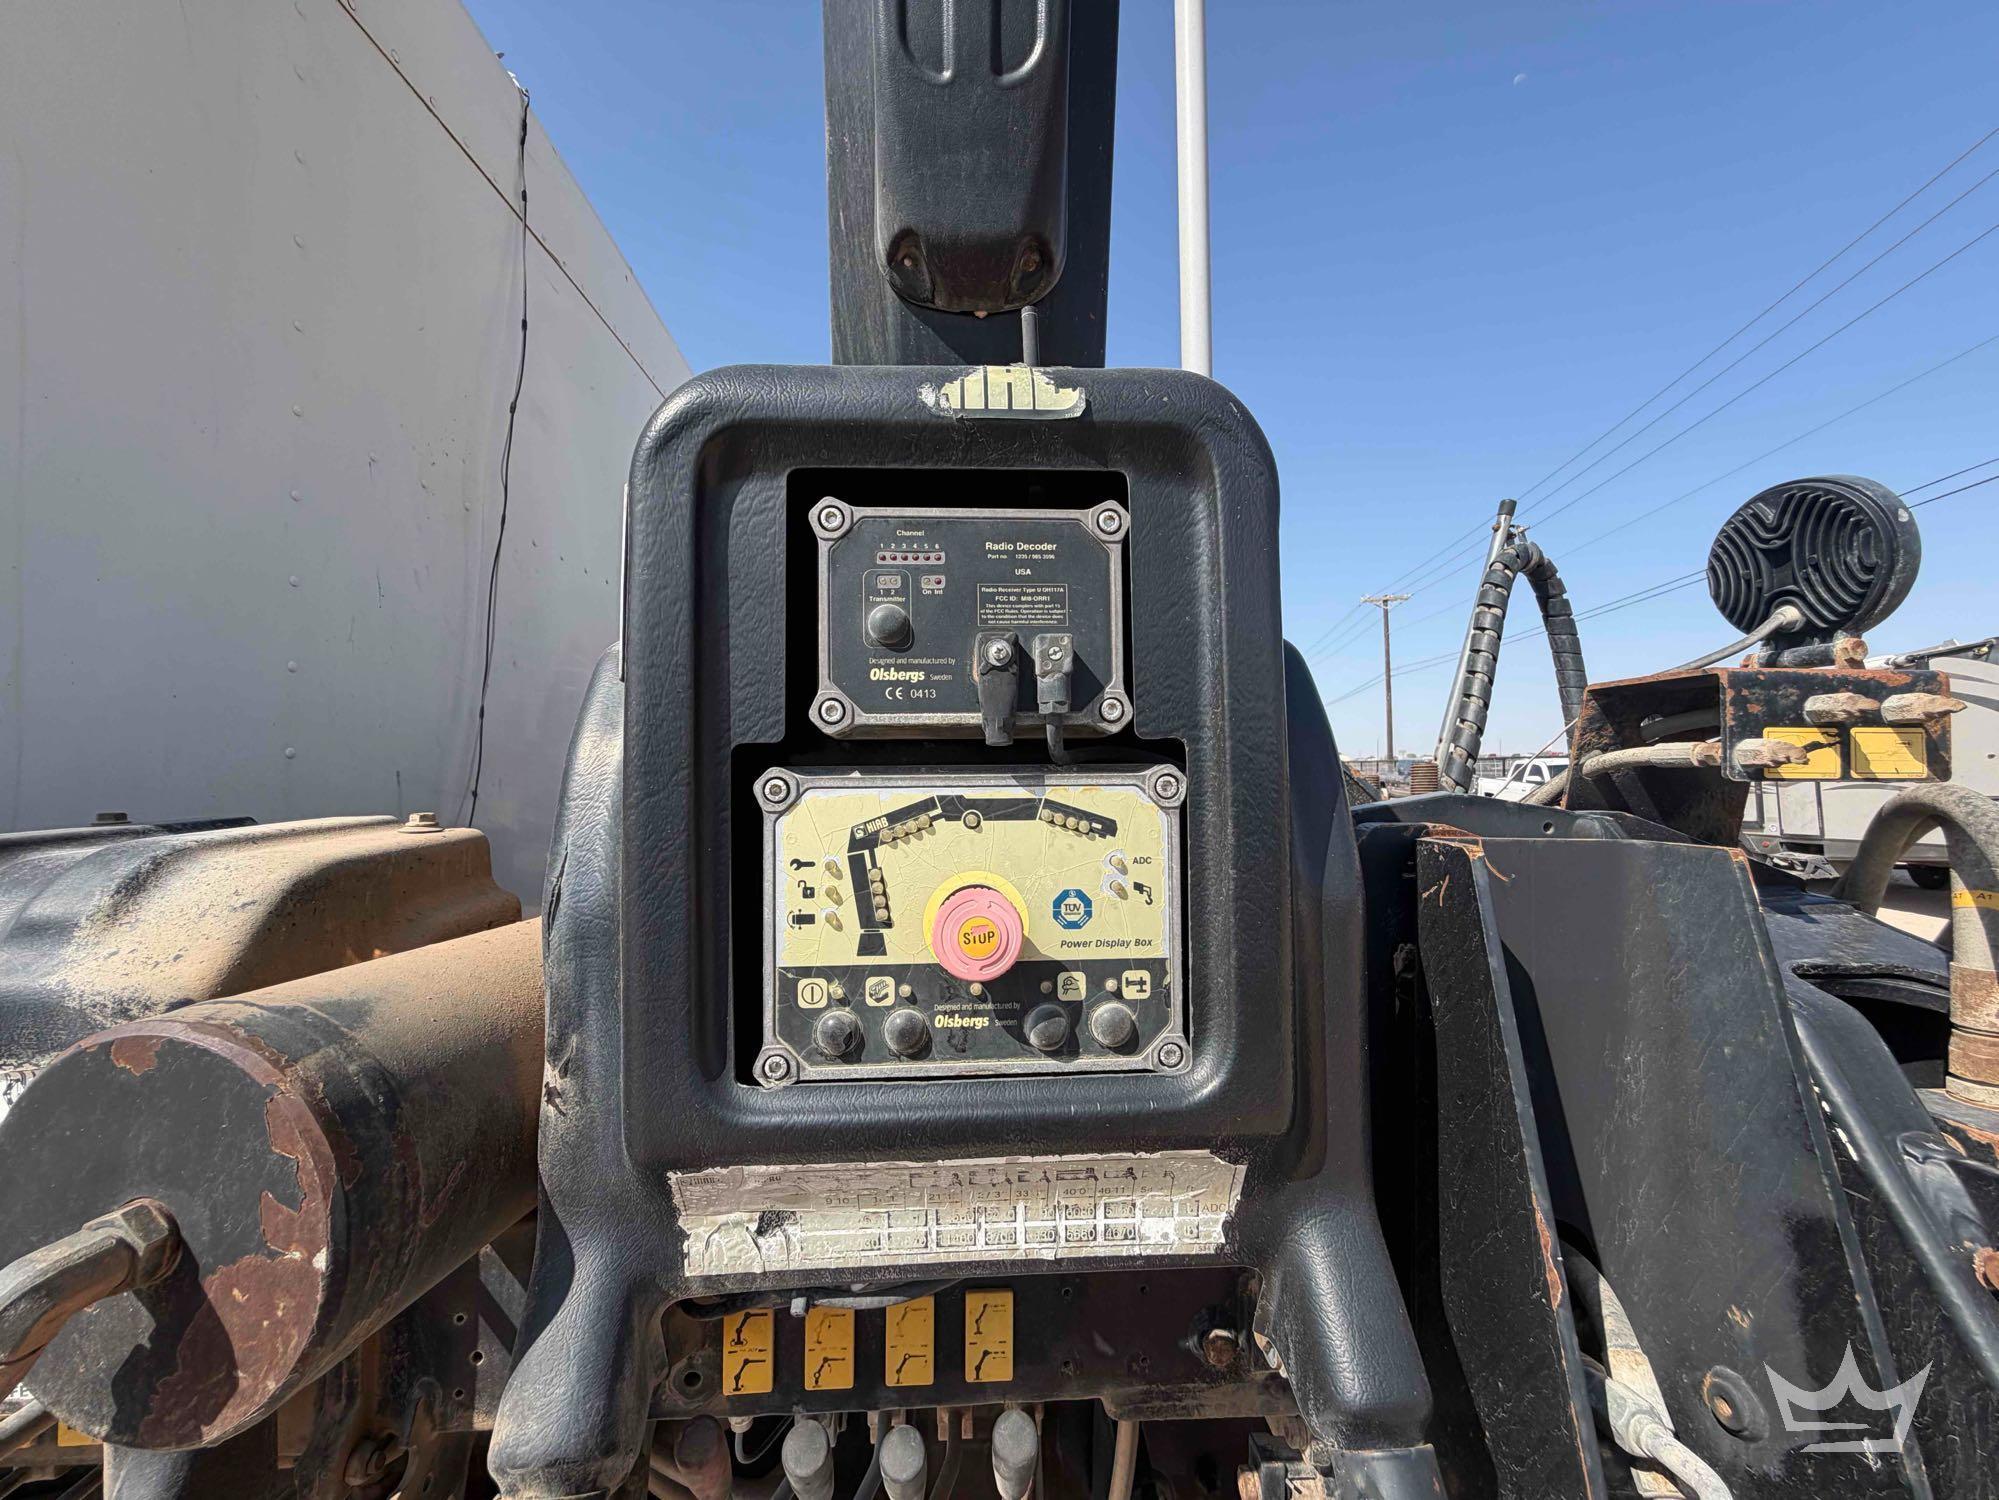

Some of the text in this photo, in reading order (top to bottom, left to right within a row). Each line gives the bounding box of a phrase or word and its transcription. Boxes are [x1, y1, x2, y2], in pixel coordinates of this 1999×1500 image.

[985, 542, 1057, 551] Radio Decoder
[1015, 568, 1032, 576] USA
[870, 667, 925, 683] Olsbergs
[910, 689, 936, 698] 0413
[866, 816, 889, 833] HIAB
[1132, 856, 1152, 865] ADC
[1060, 938, 1152, 949] Power Display Box
[934, 1003, 961, 1012] Designed
[974, 1002, 1012, 1010] manufactured
[934, 1014, 989, 1029] Olsbergs
[1202, 1204, 1226, 1212] ADC
